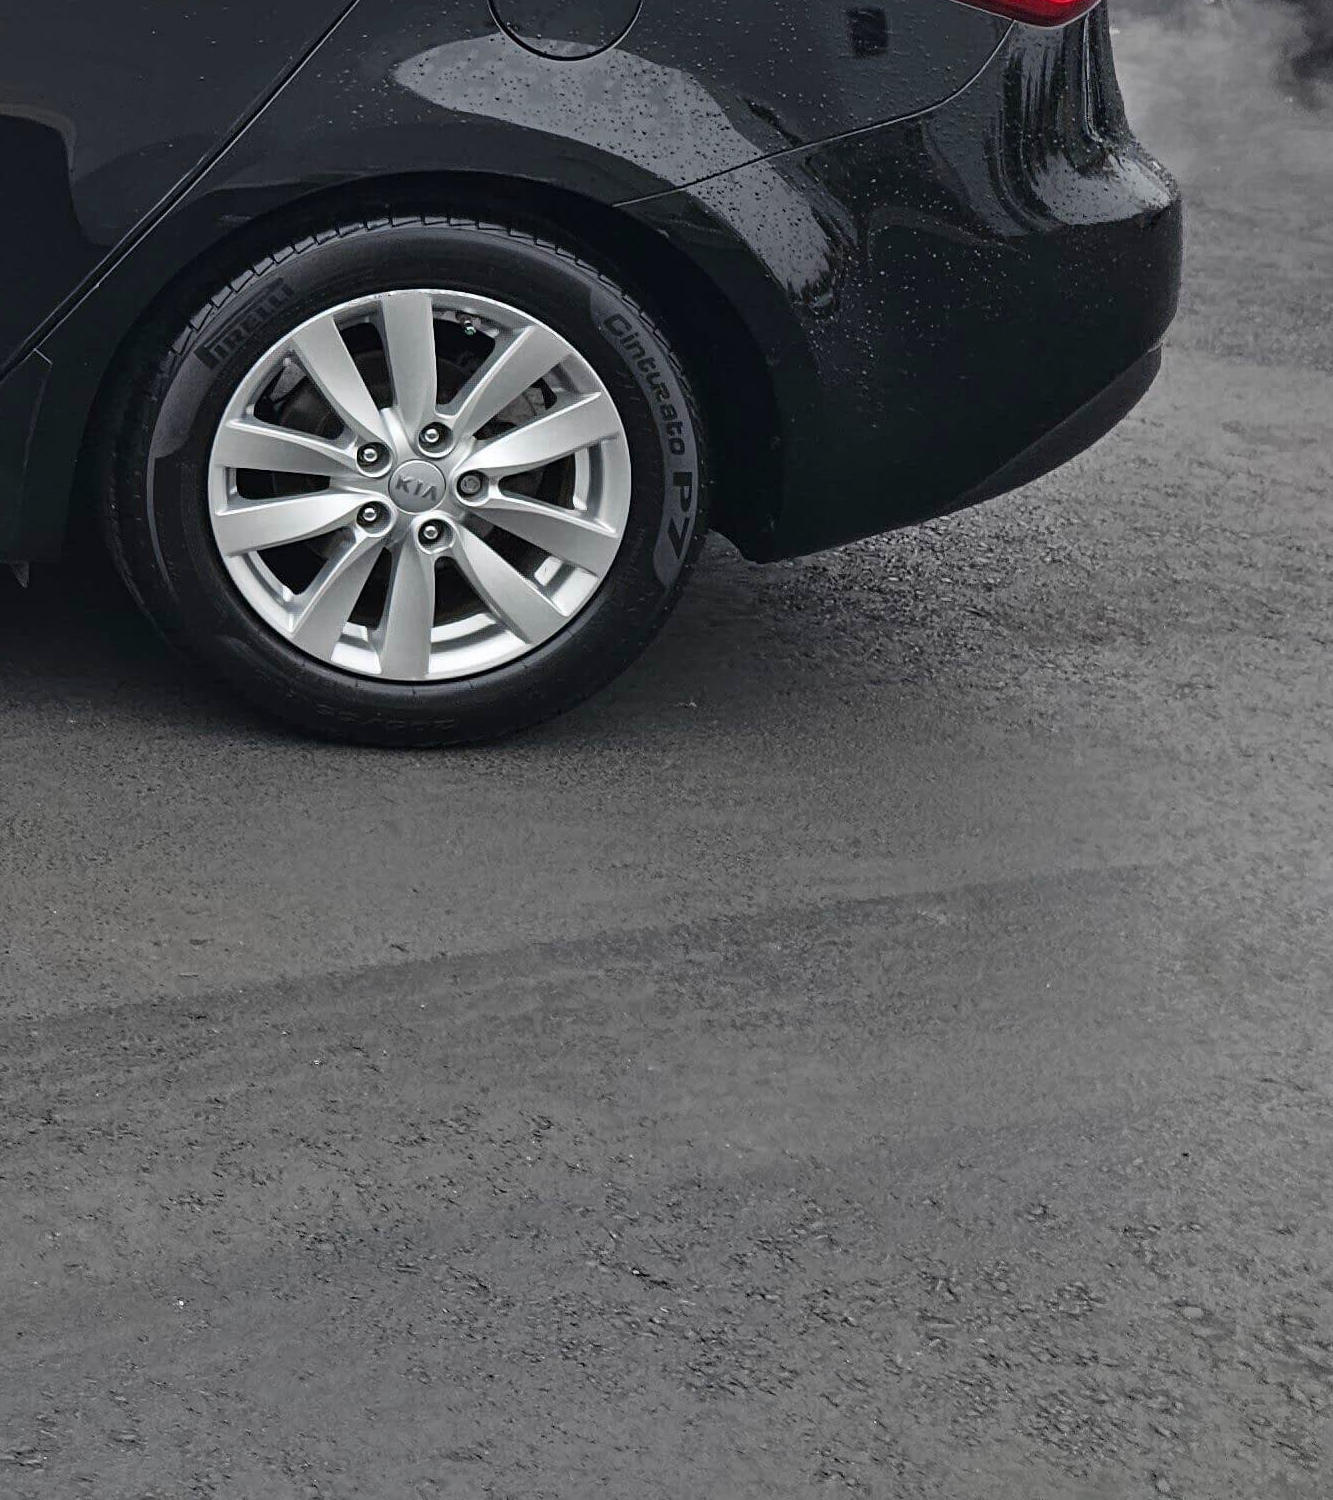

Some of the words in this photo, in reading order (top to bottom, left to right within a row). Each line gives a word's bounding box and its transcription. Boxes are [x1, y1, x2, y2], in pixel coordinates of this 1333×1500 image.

[395, 474, 438, 501] KIA
[603, 313, 686, 456] Cinturato
[666, 470, 694, 561] P7
